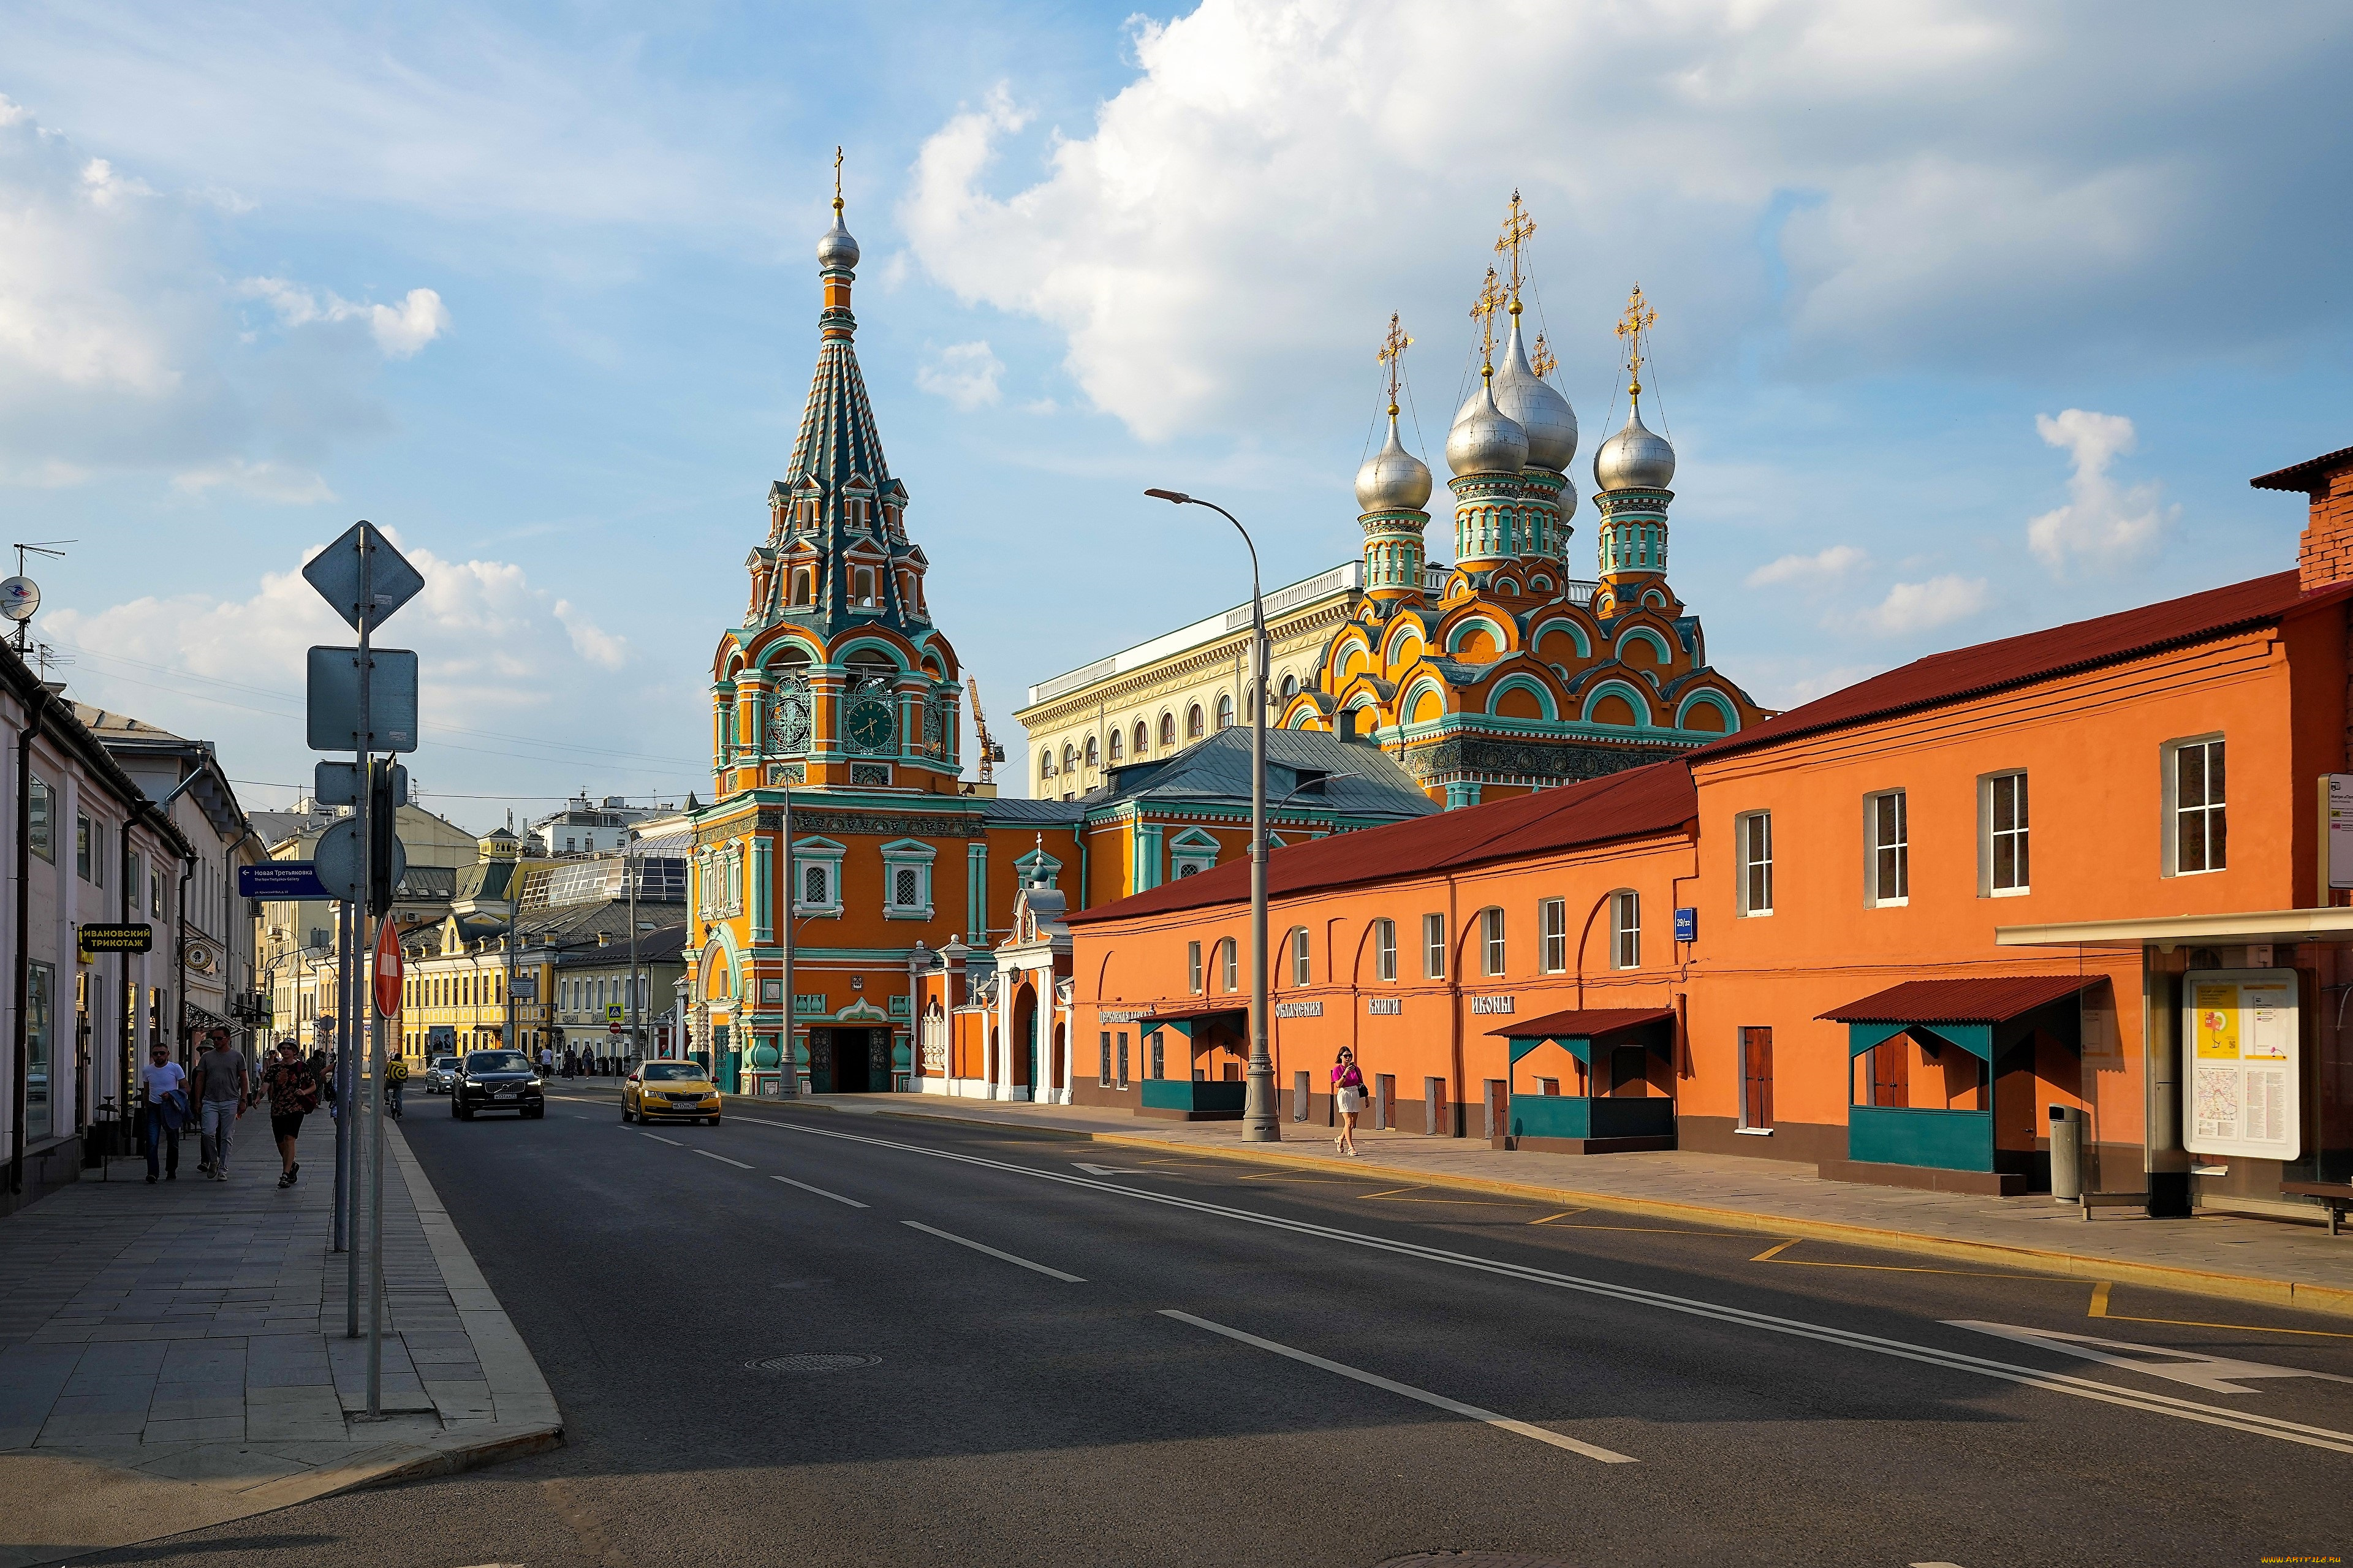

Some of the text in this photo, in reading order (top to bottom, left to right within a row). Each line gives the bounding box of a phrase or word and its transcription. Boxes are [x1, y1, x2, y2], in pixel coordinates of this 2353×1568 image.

[1677, 918, 1690, 927] 29/32
[84, 928, 150, 937] ИВАНОВСКИЙ
[1275, 1001, 1321, 1018] ОБЛАЧЕНИЯ
[1368, 999, 1400, 1014] КНИГИ
[1471, 996, 1512, 1013] ИКОНЫ
[1099, 1011, 1129, 1025] ЦЕРКОВНАЯ
